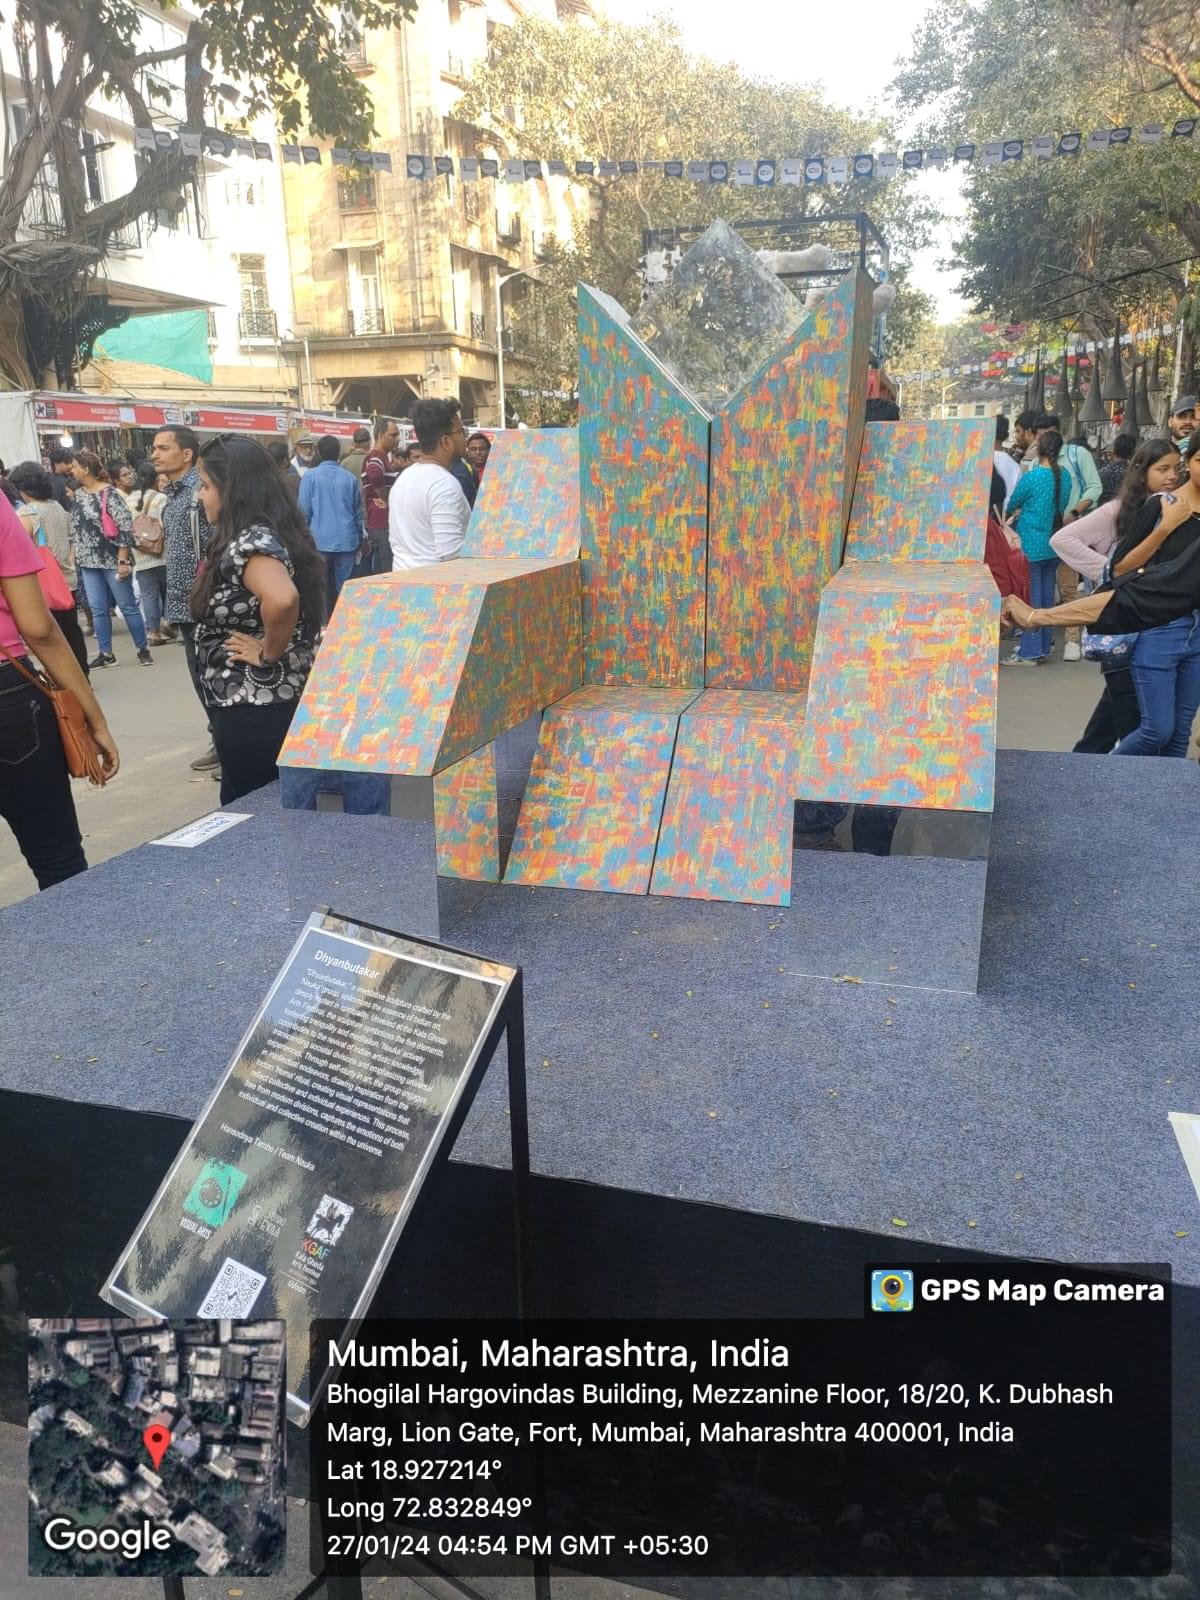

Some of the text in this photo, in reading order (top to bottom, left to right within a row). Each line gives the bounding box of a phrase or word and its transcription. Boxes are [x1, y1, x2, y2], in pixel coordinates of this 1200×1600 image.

[314, 950, 381, 979] Dhyanbutakar
[278, 1149, 296, 1163] Team
[295, 1157, 315, 1171] Nauka
[180, 1216, 213, 1240] VISUAL ARTS
[300, 1238, 330, 1262] KGAF
